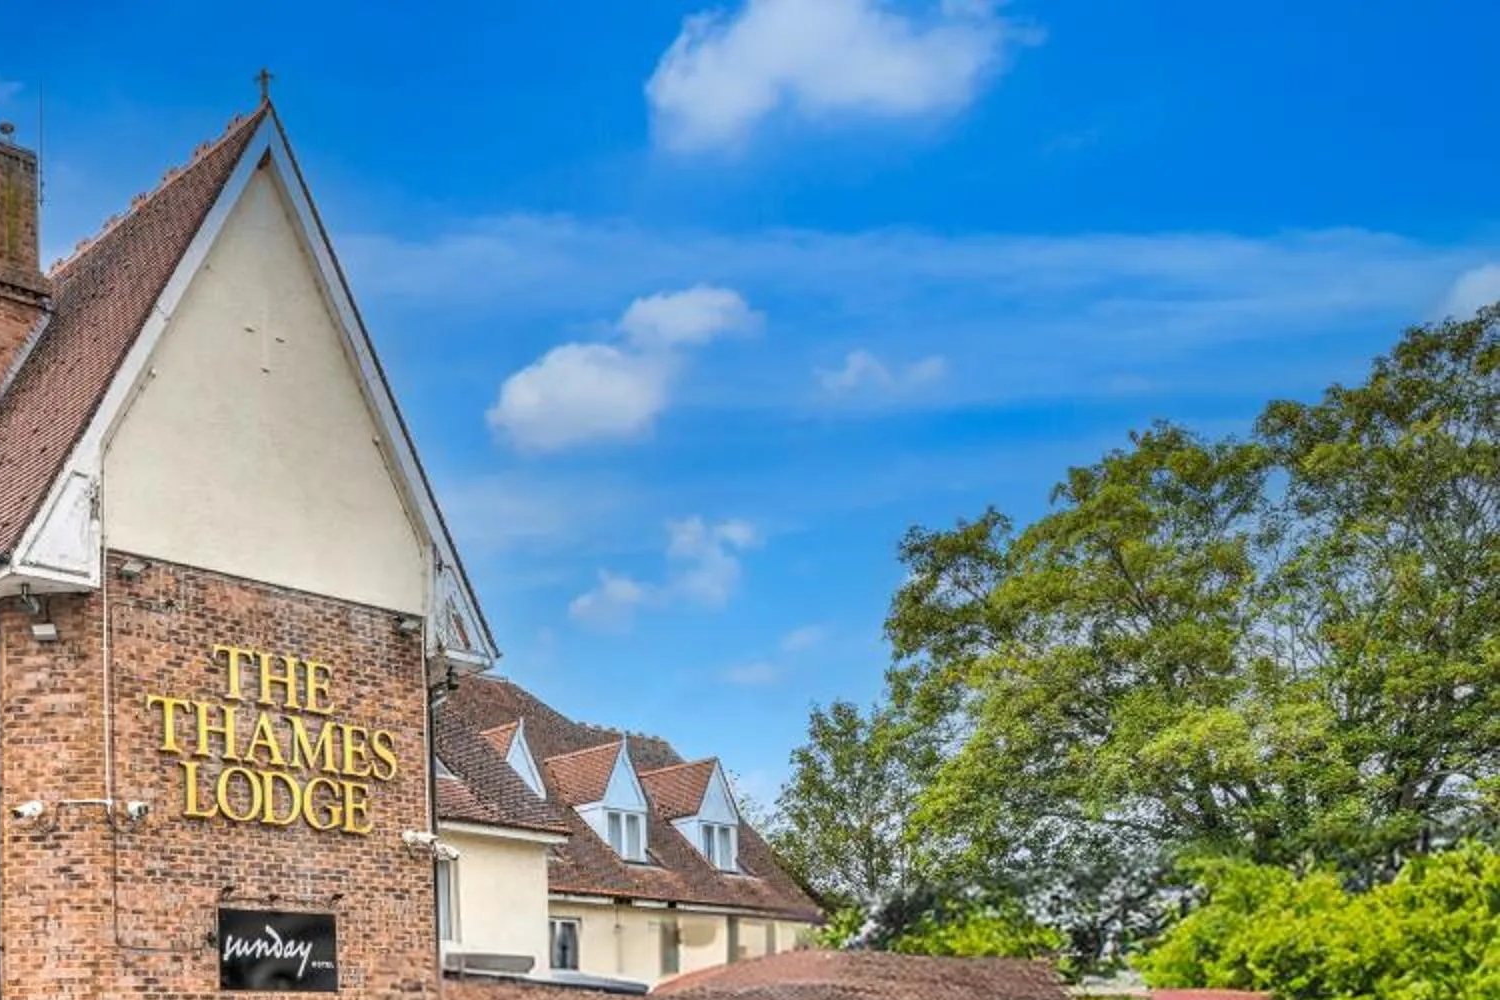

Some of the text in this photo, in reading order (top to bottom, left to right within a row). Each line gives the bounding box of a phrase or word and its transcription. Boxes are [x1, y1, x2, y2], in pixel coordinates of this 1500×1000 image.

[213, 644, 336, 715] THE
[147, 694, 398, 782] THAMES
[179, 760, 374, 835] LODGE
[222, 924, 313, 977] sunday
